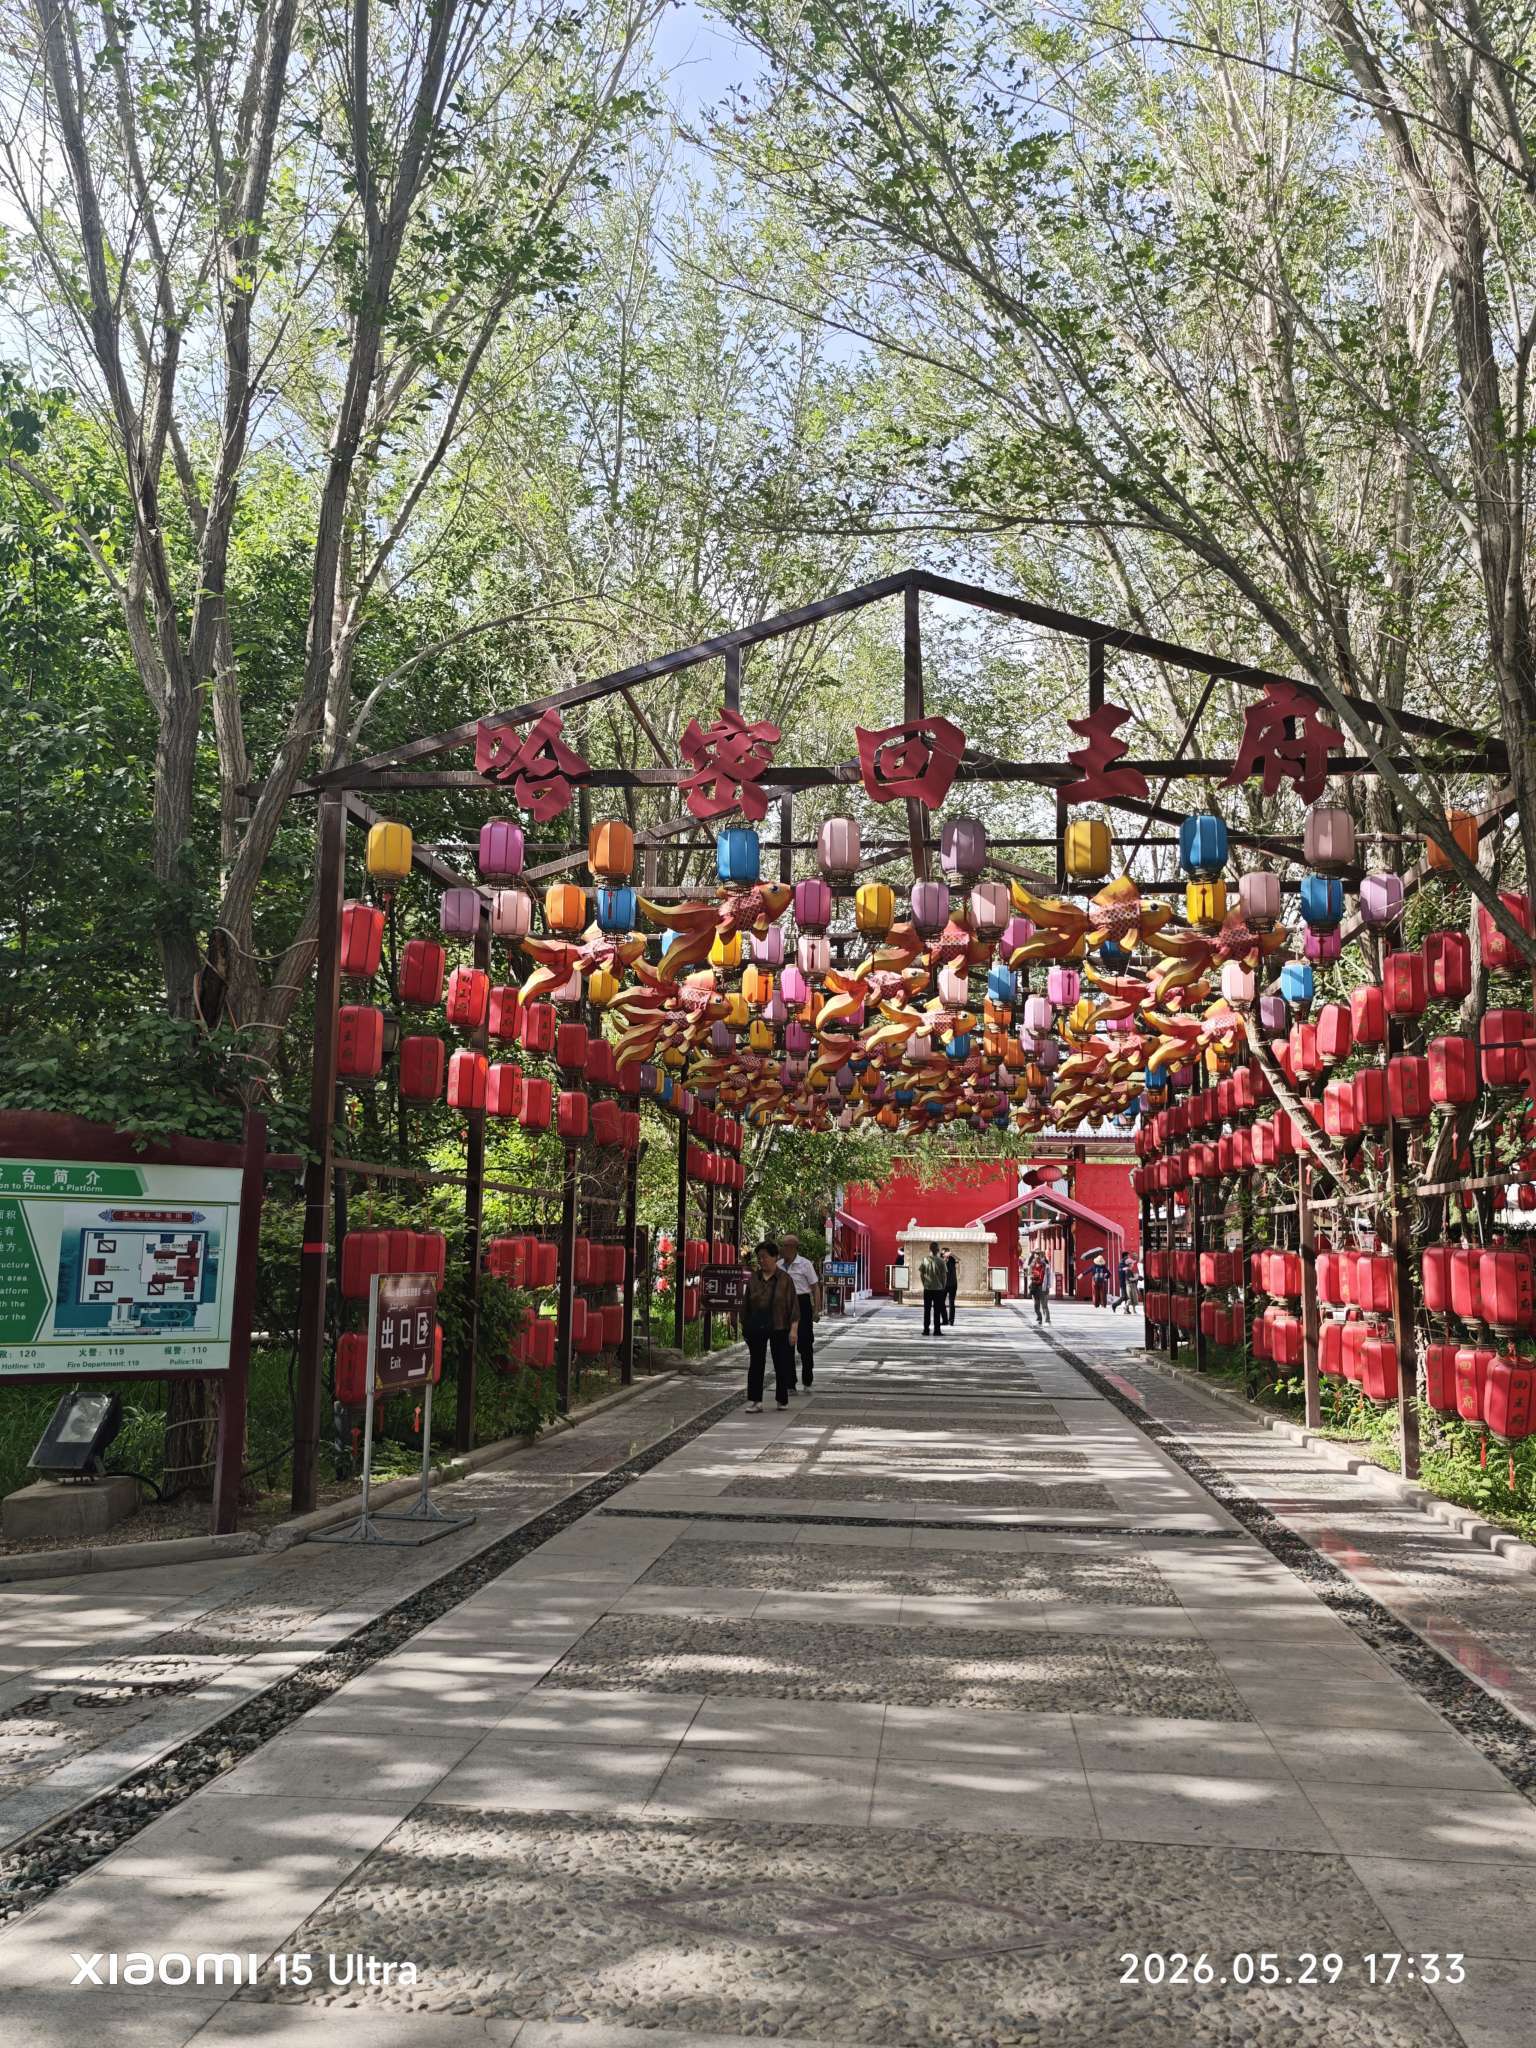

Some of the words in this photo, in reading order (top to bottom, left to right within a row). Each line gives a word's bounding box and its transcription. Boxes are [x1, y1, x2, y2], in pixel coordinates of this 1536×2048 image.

[475, 682, 1346, 823] 哈密回王府
[0, 1167, 100, 1186] 台简介
[66, 1184, 103, 1192] Platform
[381, 1316, 411, 1349] 出口
[390, 1356, 401, 1370] Exit
